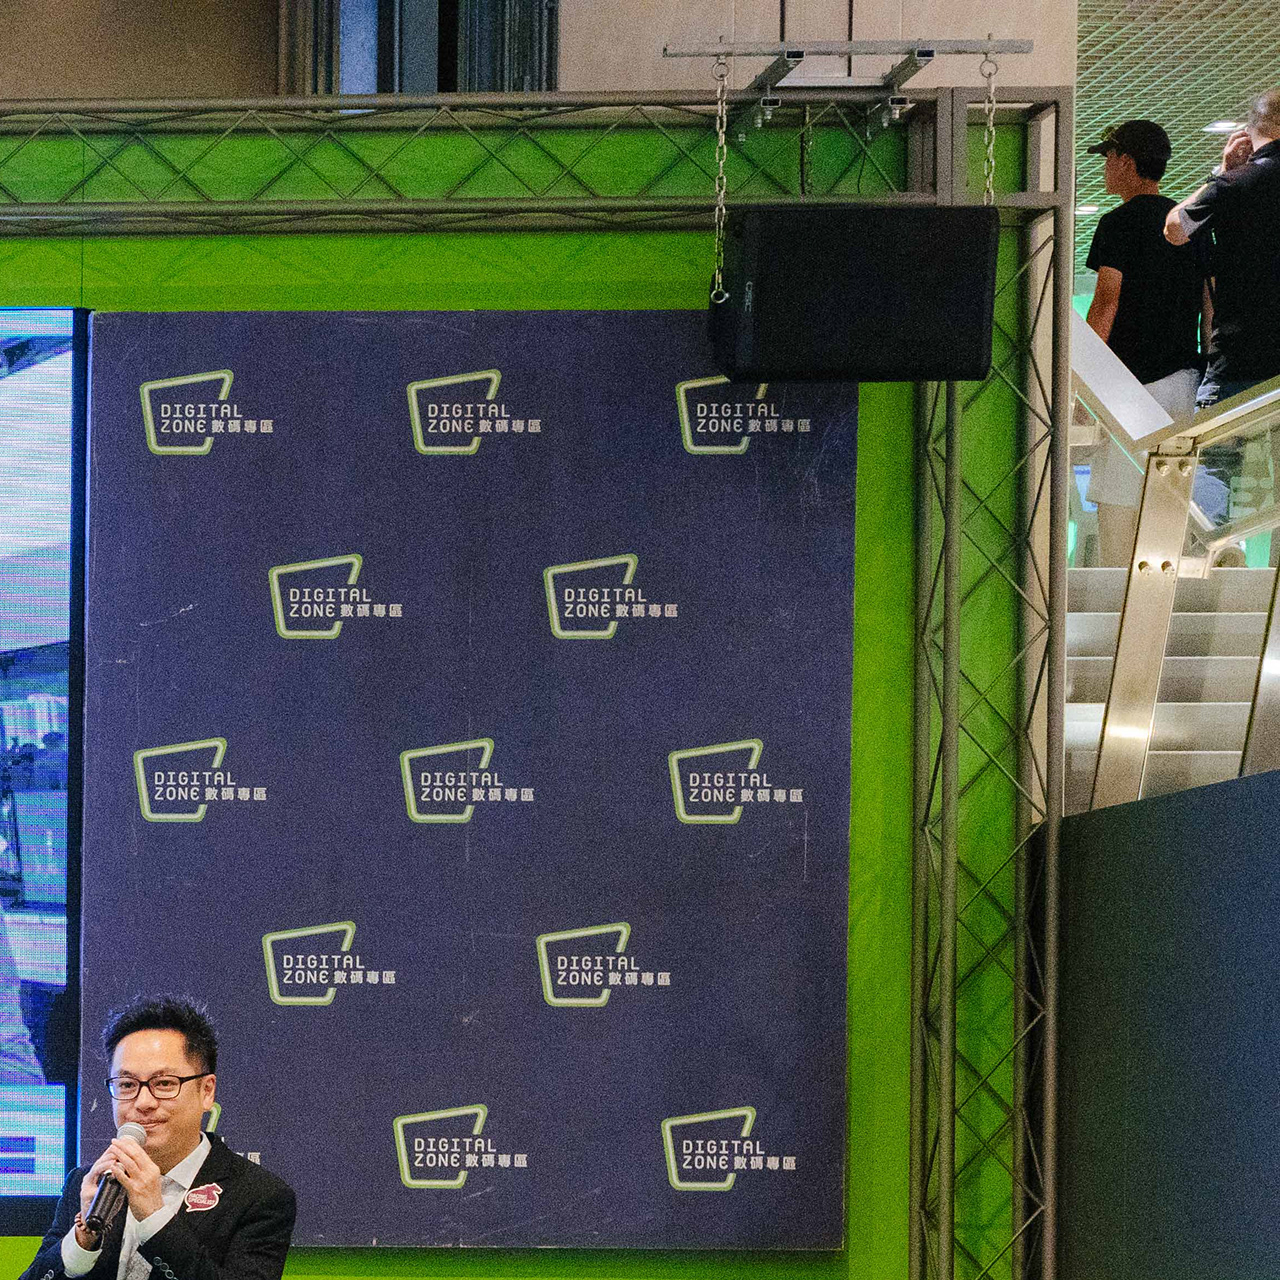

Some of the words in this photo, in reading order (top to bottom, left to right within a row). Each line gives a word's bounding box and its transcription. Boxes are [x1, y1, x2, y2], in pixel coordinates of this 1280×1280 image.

[161, 403, 242, 418] DIGITAL
[428, 403, 510, 418] DIGITAL
[697, 402, 779, 417] DIGITAL
[161, 418, 206, 433] ZONE
[212, 420, 273, 433] 數碼專區
[428, 418, 473, 433] ZONE
[479, 420, 541, 432] 數碼專區
[697, 417, 742, 432] ZONE
[748, 419, 810, 432] 數碼專區
[290, 587, 371, 602] DIGITAL
[564, 587, 646, 602] DIGITAL
[290, 602, 335, 617] ZONE
[341, 604, 402, 617] 數碼專區
[565, 602, 610, 617] ZONE
[616, 604, 677, 617] 數碼專區
[155, 771, 235, 786] DIGITAL
[421, 771, 502, 786] DIGITAL
[690, 772, 771, 787] DIGITAL
[155, 786, 199, 800] ZONE
[205, 787, 266, 800] 數碼專區
[421, 786, 466, 801] ZONE
[472, 788, 534, 801] 數碼專區
[689, 787, 735, 802] ZONE
[741, 789, 802, 802] 數碼專區
[283, 954, 364, 969] DIGITAL
[557, 955, 639, 970] DIGITAL
[283, 969, 328, 984] ZONE
[334, 971, 395, 984] 數碼專區
[557, 970, 602, 985] ZONE
[609, 972, 670, 985] 數碼專區
[415, 1137, 496, 1152] DIGITAL
[683, 1139, 764, 1154] DIGITAL
[415, 1152, 459, 1167] ZONE
[466, 1154, 527, 1167] 數碼專區
[683, 1154, 728, 1169] ZONE
[734, 1156, 795, 1170] 數碼專區
